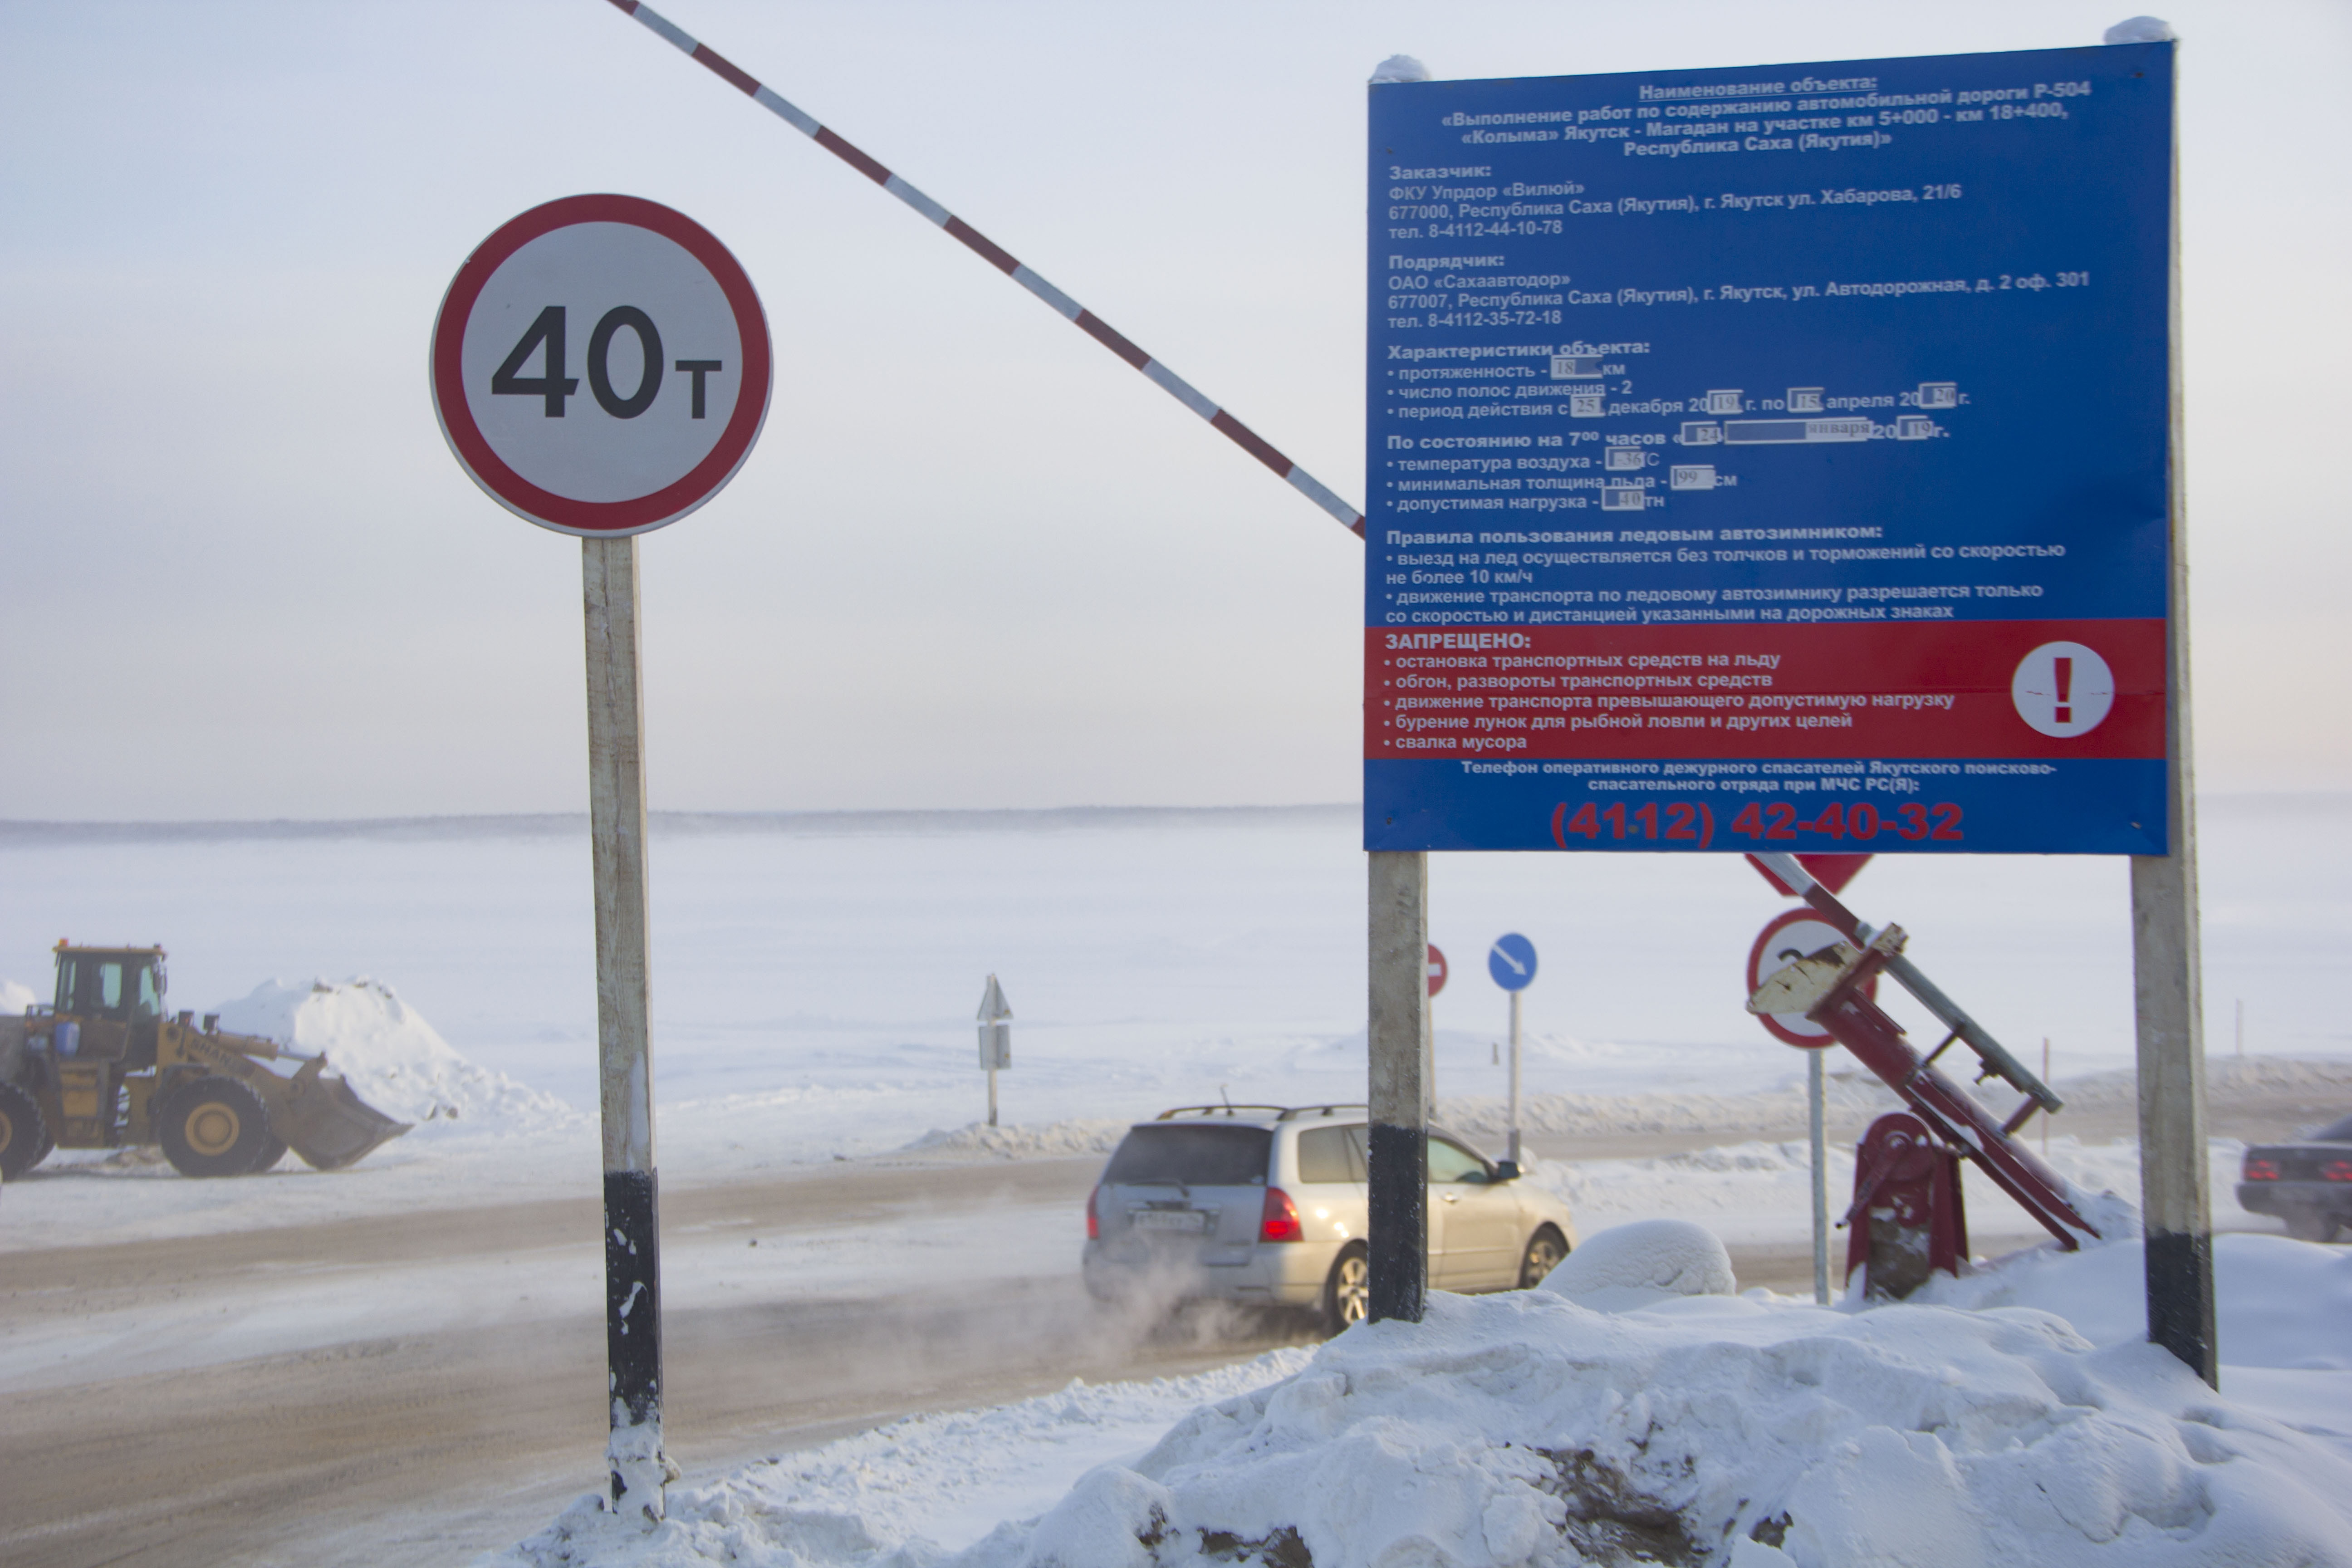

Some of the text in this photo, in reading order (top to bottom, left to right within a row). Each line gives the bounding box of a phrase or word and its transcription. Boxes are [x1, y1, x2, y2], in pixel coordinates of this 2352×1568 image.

[1639, 77, 1877, 99] Наименование объекта:
[1441, 111, 1573, 127] «Выполнение
[1578, 105, 1632, 124] работ
[1637, 107, 1661, 119] по
[1665, 100, 1792, 118] содержанию
[1797, 89, 1952, 111] автомобильной
[1957, 88, 2028, 106] дороги
[1461, 129, 1559, 144] «Колыма»
[1563, 126, 1630, 142] Якутск
[1646, 122, 1729, 137] Магадан
[1734, 121, 1759, 133] на
[1763, 117, 1842, 134] участке
[1846, 115, 1873, 127] км
[1955, 110, 1983, 122] км
[1624, 131, 1891, 157] Республика Саха (Якутия)»
[1389, 165, 1491, 181] Заказчик:
[1388, 186, 1427, 201] ФКУ
[1388, 183, 1962, 220] 677000, Республика Саха (Якутия), Якутск ул. Хабарова, 21/6
[1388, 219, 1563, 239] тел. 8-4112-44-10-78
[1388, 255, 1504, 271] Подрядчик:
[1388, 274, 1571, 290] ОАО «Сахаавтодор»
[1388, 271, 2088, 310] 677007, Республика Саха (Якутия), Якутск, ул. Автодорожная, оф. 301
[1387, 309, 1562, 328] тел. 8-4112-35-72-18
[1387, 340, 1650, 361] Характеристики объекта:
[1399, 366, 1536, 383] протяженность
[1398, 384, 1607, 399] число полос движения
[1398, 406, 1464, 421] период
[1467, 402, 1553, 420] действия
[1607, 398, 1683, 416] декабря
[1761, 399, 1785, 411] по
[1826, 396, 1894, 411] апреля
[1387, 435, 1414, 450] По
[1419, 436, 1532, 449] состоянию
[1537, 436, 1563, 447] на
[1605, 433, 1666, 448] часов
[1397, 458, 1512, 474] температура
[1517, 457, 1591, 472] воздуха
[1398, 478, 1521, 491] минимальная
[1525, 477, 1605, 491] толщина
[1396, 498, 1504, 514] допустимая
[1509, 497, 1587, 513] нагрузка
[1387, 526, 1882, 548] Правила пользования ледовым автозимником:
[1397, 544, 2066, 567] выезд на лед осуществляется без толчков торможений со скоростью
[1386, 568, 1533, 585] не более 10 км/ч
[1396, 585, 2043, 607] движение транспорта по ледовому автозимнику разрешается только
[1385, 606, 1955, 626] со скоростью дистанцией указанными на дорожных знаках
[1385, 632, 1531, 652] ЗАПРЕЩЕНО:
[1396, 654, 1781, 671] остановка транспортных средств на льду
[1396, 673, 1773, 692] обгон, развороты транспортных средств
[1395, 694, 1955, 711] движение транспорта превышающего допустимую нагрузку
[1395, 712, 1852, 732] бурение лунок для рыбной ловли других целей
[1395, 737, 1527, 752] свалка мусора
[1460, 760, 2057, 775] Телефон оперативного дежурного спасателей Якутского поисково-
[1588, 780, 1716, 791] спасательного
[1720, 780, 1779, 793] отряда
[1783, 780, 1817, 794] при
[1820, 777, 1861, 792] МЧС
[1733, 803, 1962, 840] 42-40-32
